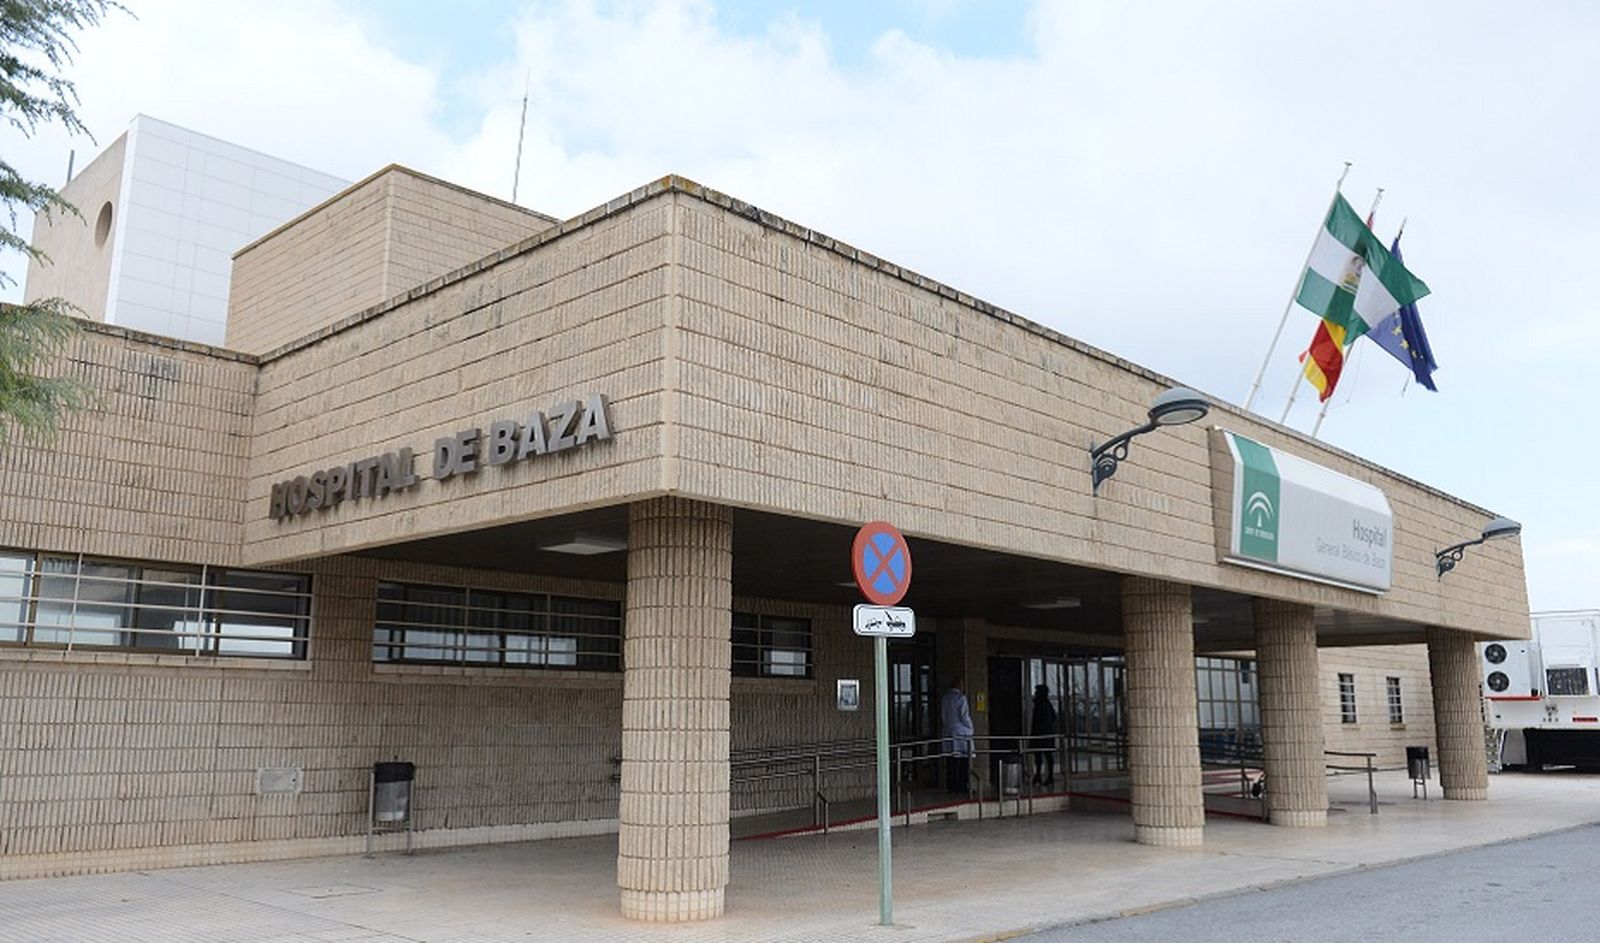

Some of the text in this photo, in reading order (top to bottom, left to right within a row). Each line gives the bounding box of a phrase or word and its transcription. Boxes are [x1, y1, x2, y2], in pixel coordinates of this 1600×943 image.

[269, 393, 613, 520] HOSPITAL DE BAZA
[1353, 518, 1387, 549] Hospital
